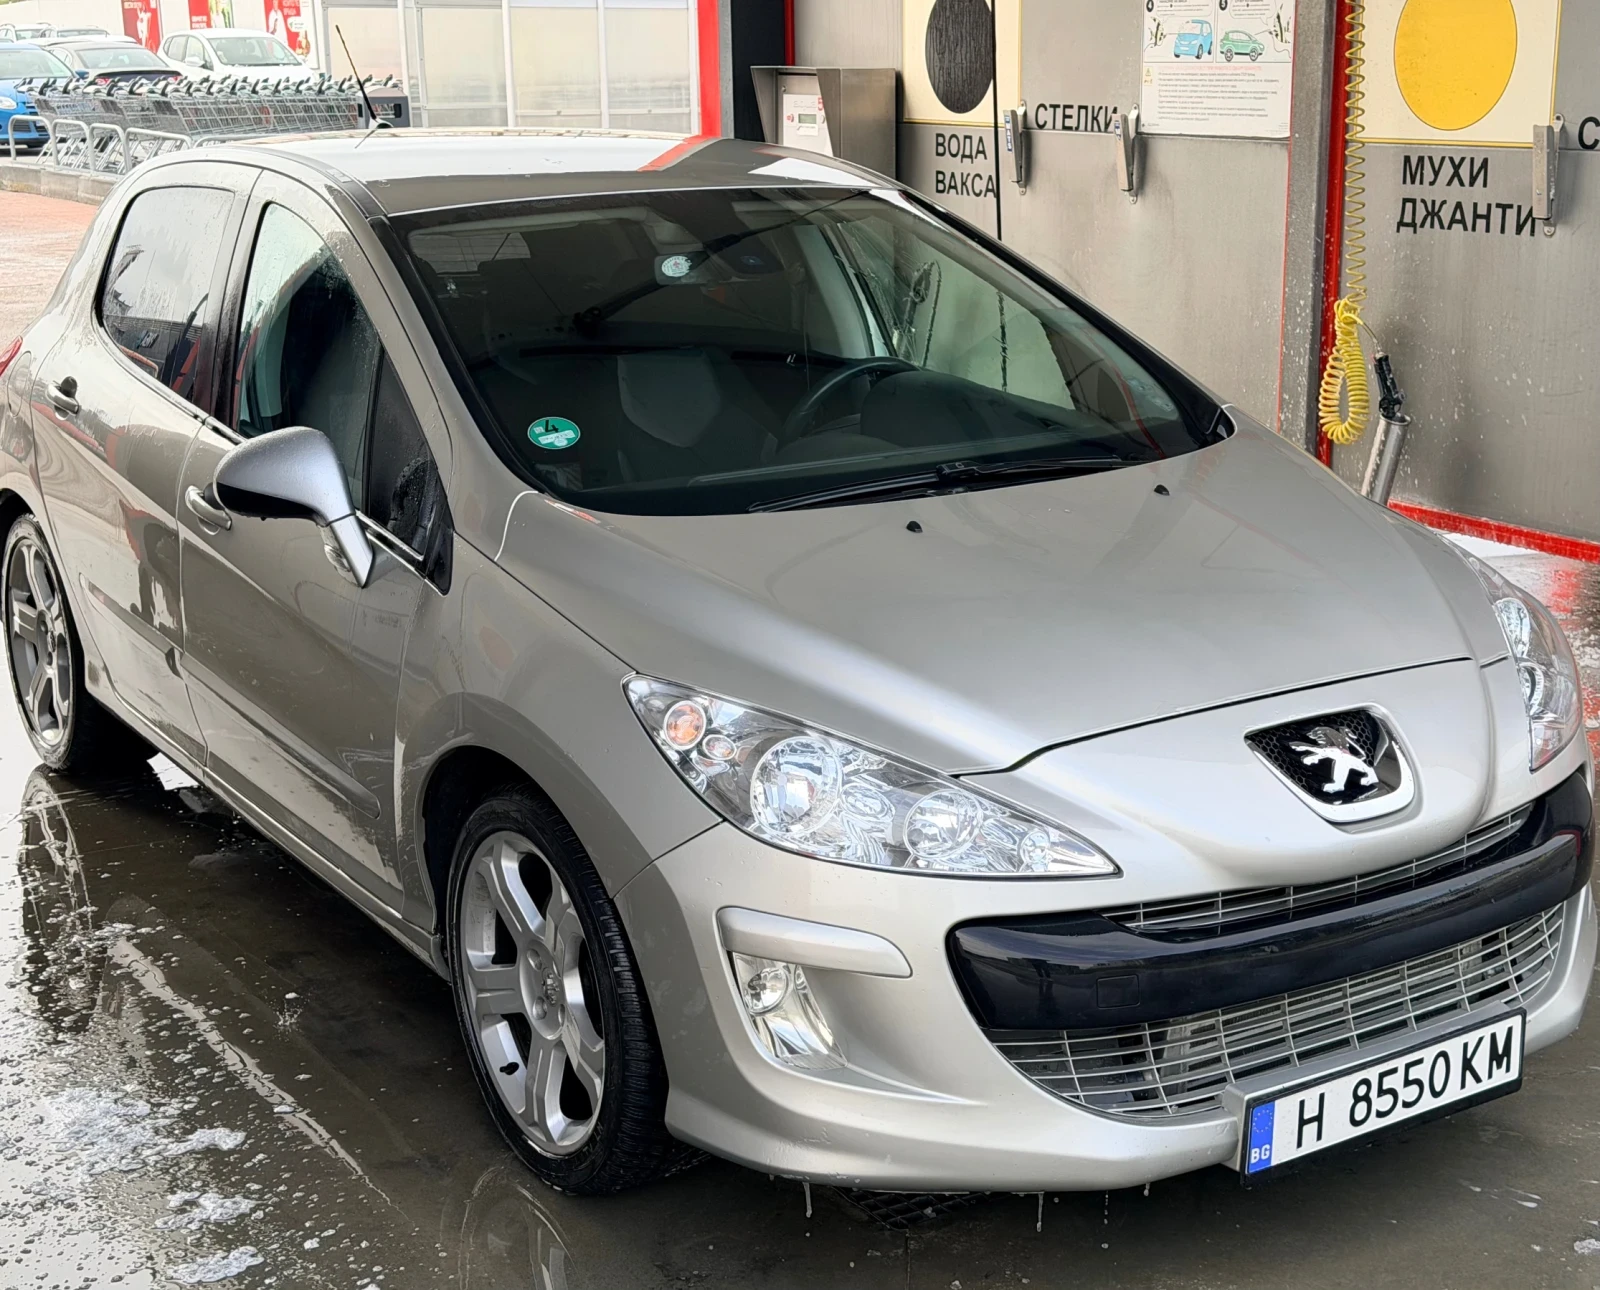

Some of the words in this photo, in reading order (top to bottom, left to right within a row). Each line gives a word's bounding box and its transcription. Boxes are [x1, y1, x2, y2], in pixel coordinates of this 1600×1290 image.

[1035, 103, 1118, 132] СТЕЛКИ
[936, 133, 987, 164] ВОДА
[936, 170, 996, 198] ВАКСА
[1402, 155, 1489, 188] МУХИ
[1396, 197, 1536, 236] ДЖАНТИ
[544, 420, 559, 433] 4
[1296, 1092, 1326, 1149] H
[1349, 1050, 1451, 1127] 8550
[1460, 1026, 1514, 1090] KM
[1250, 1144, 1271, 1164] BG
